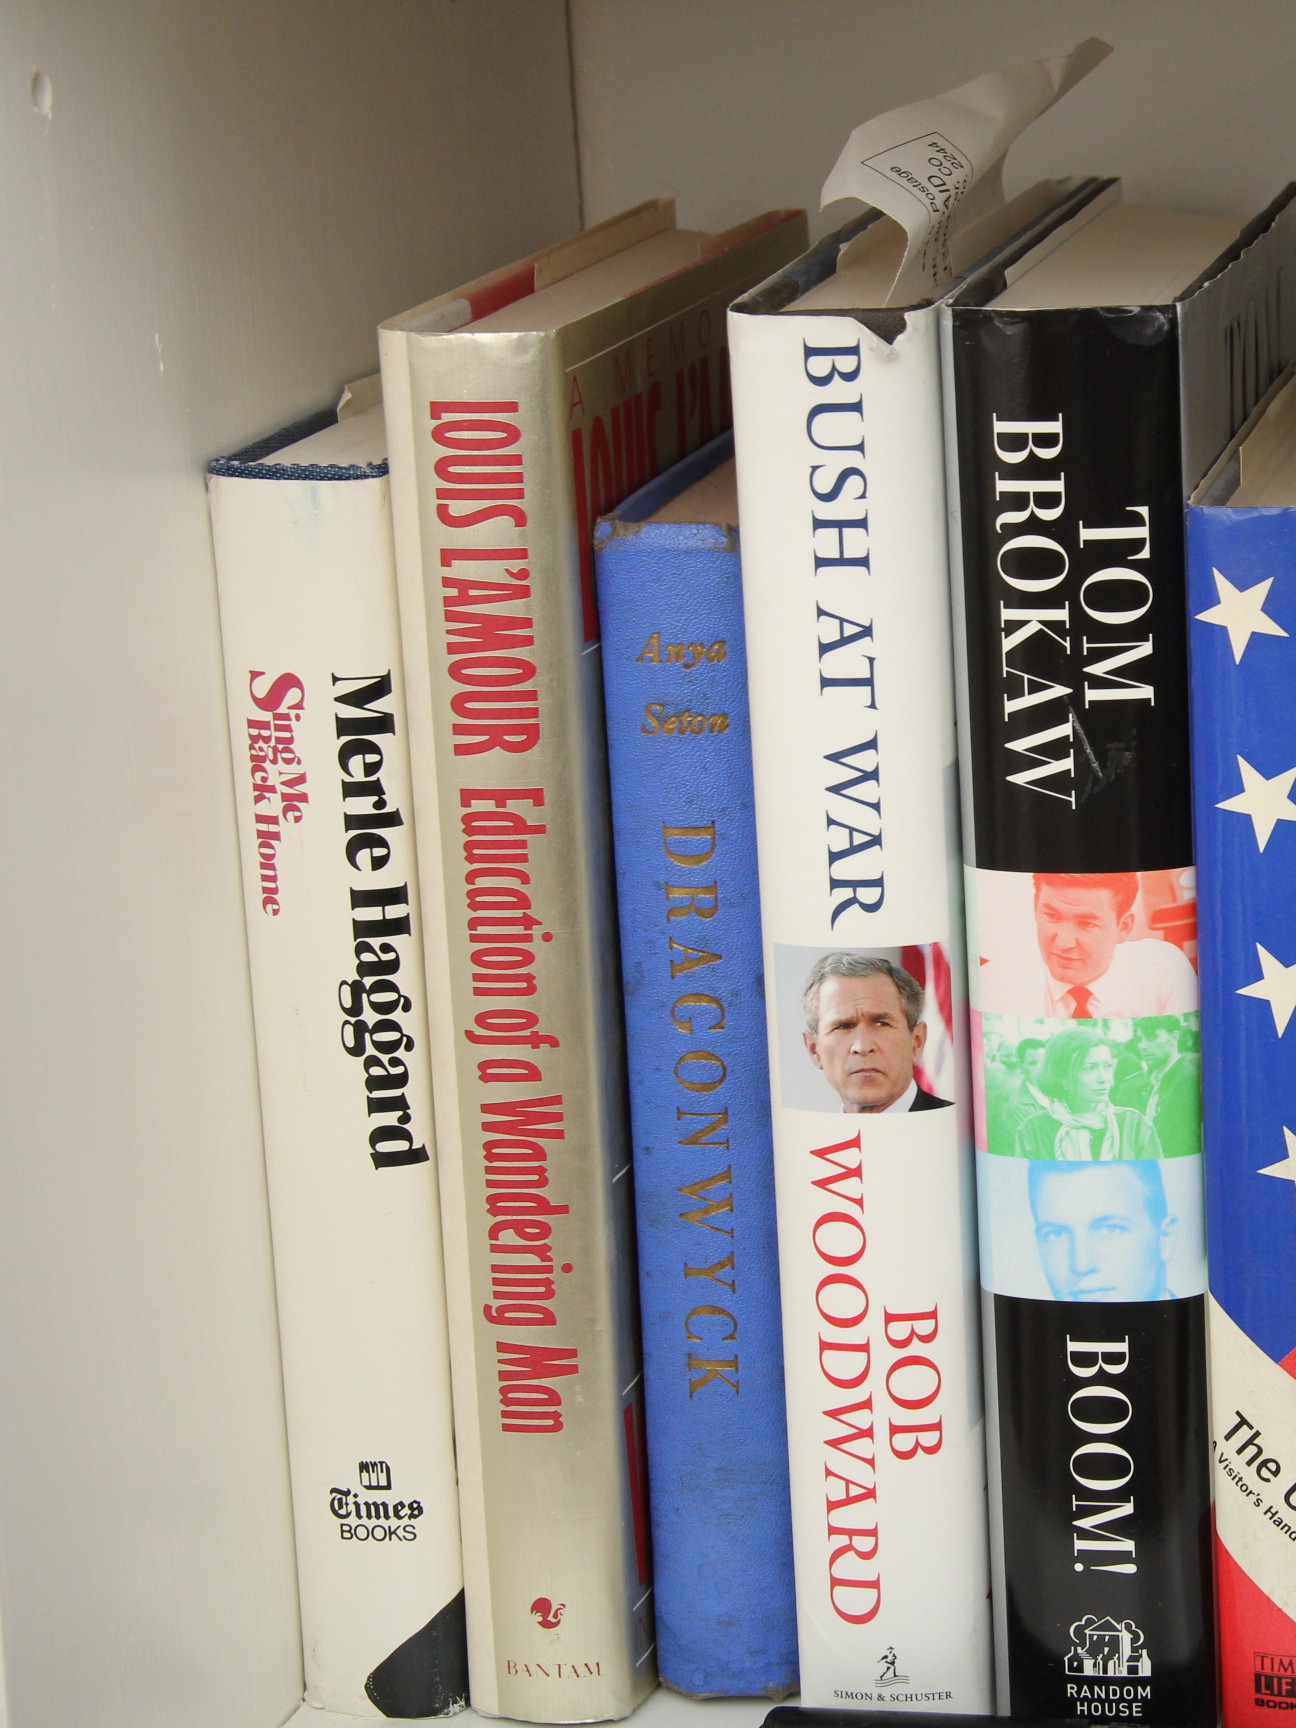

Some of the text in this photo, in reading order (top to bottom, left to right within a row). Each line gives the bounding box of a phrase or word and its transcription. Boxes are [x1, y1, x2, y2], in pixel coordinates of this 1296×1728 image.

[889, 165, 940, 213] Postage
[928, 141, 964, 170] 2244
[803, 337, 886, 931] BUSH AT WAR
[993, 413, 1076, 808] BROKAW
[1078, 506, 1155, 707] TOM
[635, 632, 728, 669] Anya
[249, 670, 309, 824] Sing Me
[641, 703, 730, 739] Seton
[247, 717, 281, 916] Back Home
[332, 669, 430, 1170] Merle Haggard
[429, 400, 579, 1434] LOUIS L'AMOUR Education of a Wandering Man
[662, 822, 739, 1397] DRAGONWYCK
[809, 1128, 880, 1624] WOODWARD
[884, 1302, 943, 1460] BOB
[1067, 1335, 1137, 1575] BOOM!
[1217, 1451, 1262, 1507] Visitor's
[1224, 1410, 1281, 1483] The
[330, 1487, 424, 1520] Times
[340, 1523, 417, 1541] BOOKS
[506, 1659, 601, 1678] BANTAM
[833, 1690, 953, 1702] SIMON & SCHUSTER
[1067, 1684, 1151, 1699] RANDOM
[1077, 1702, 1142, 1716] HOUSE
